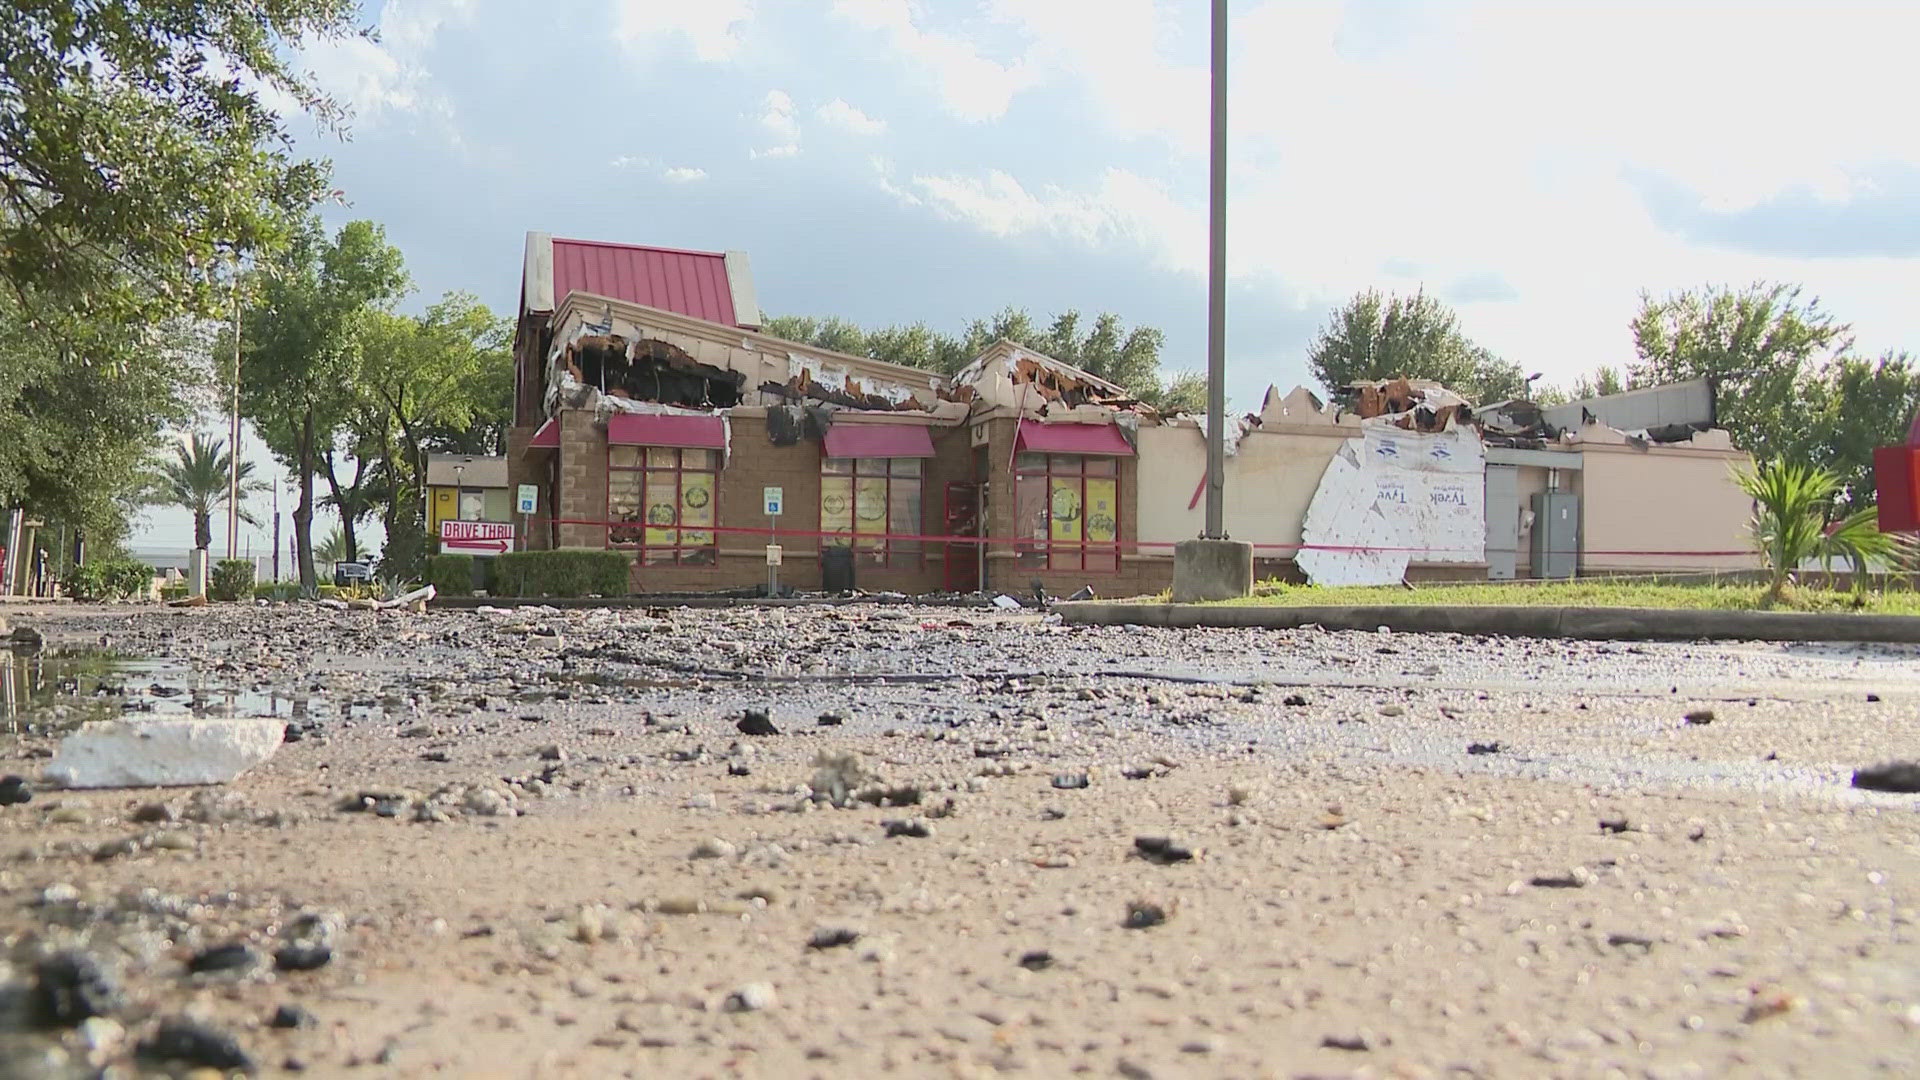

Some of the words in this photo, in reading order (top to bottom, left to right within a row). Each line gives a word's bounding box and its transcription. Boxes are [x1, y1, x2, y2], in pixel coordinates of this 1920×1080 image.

[1377, 490, 1406, 503] Tyve
[1430, 492, 1466, 505] Tyvek
[445, 523, 479, 538] DRIVE
[482, 524, 512, 539] THRU
